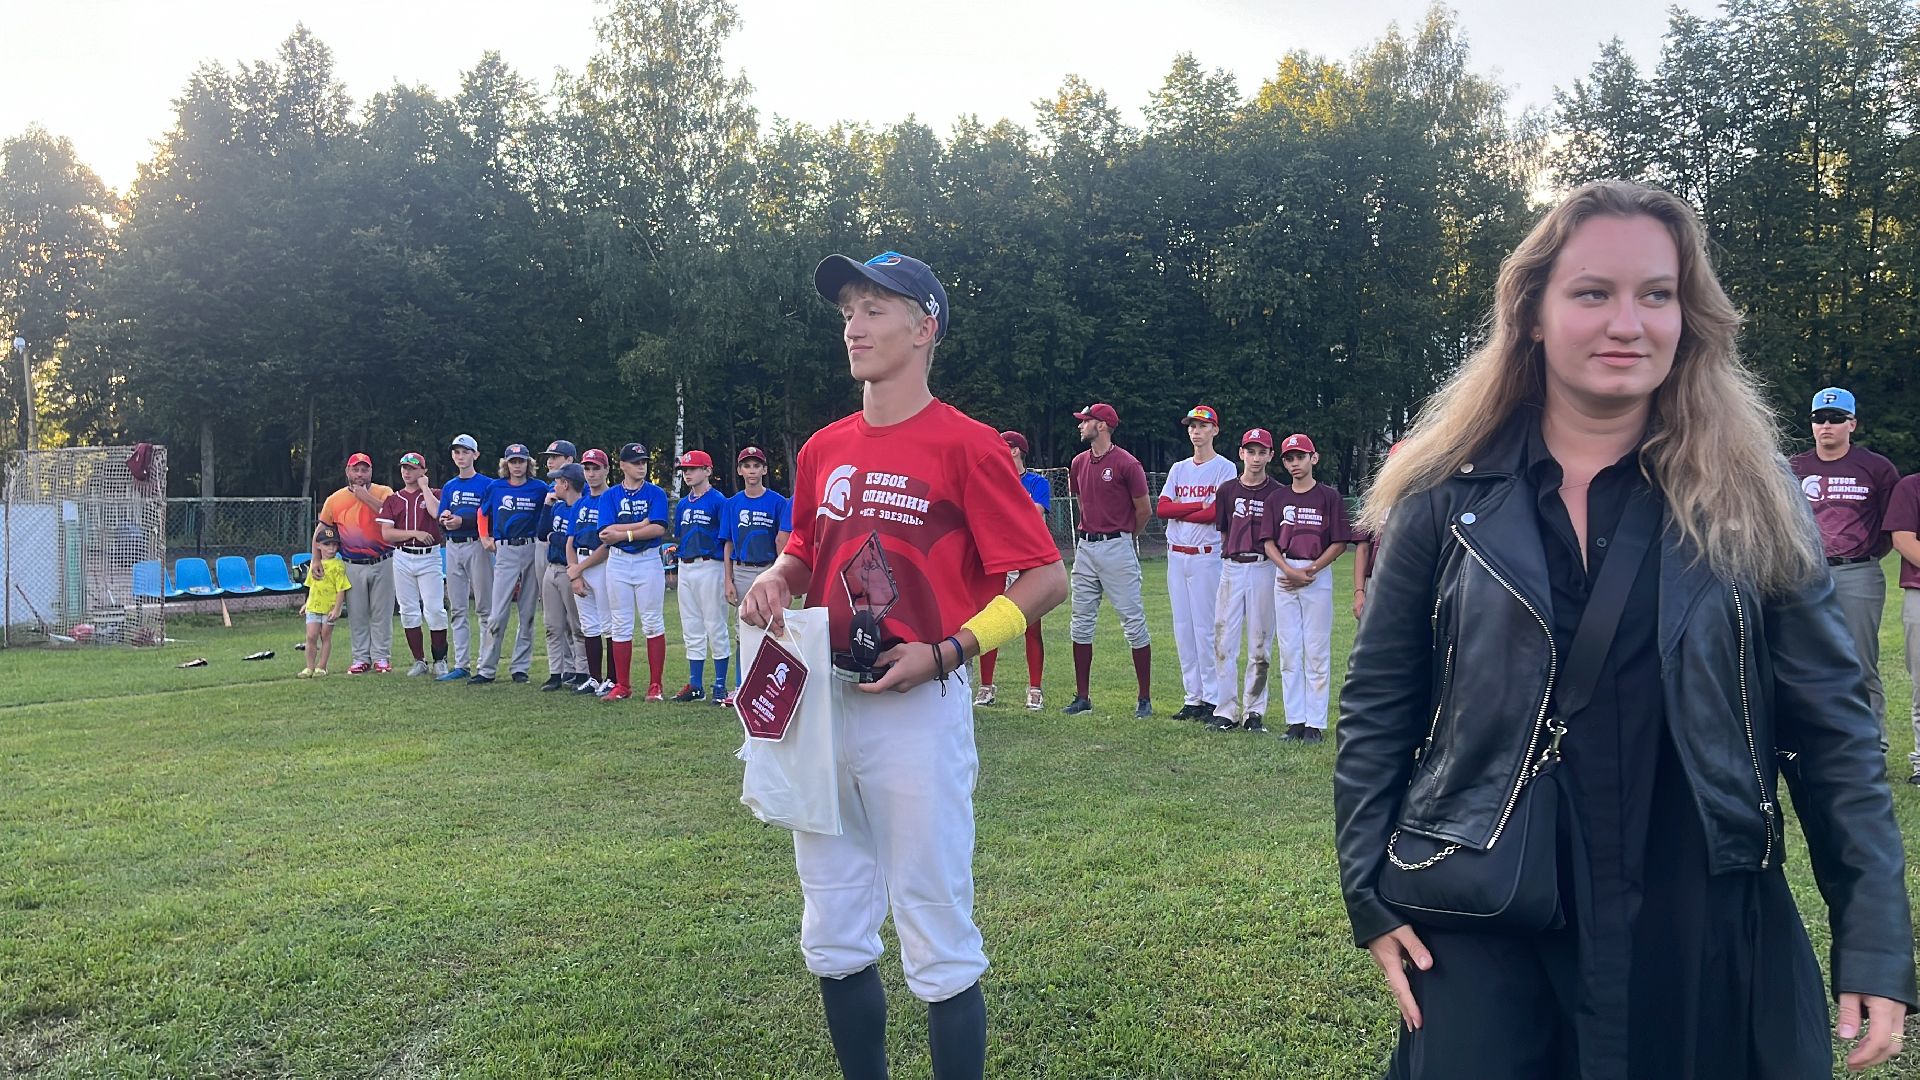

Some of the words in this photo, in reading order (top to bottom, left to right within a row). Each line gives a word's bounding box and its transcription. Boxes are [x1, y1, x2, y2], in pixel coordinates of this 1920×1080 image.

[925, 293, 940, 317] 30
[865, 472, 909, 489] КУБОК
[862, 489, 930, 513] ОЛИМПИИ
[878, 509, 924, 526] ЗВЕЗДЫ»
